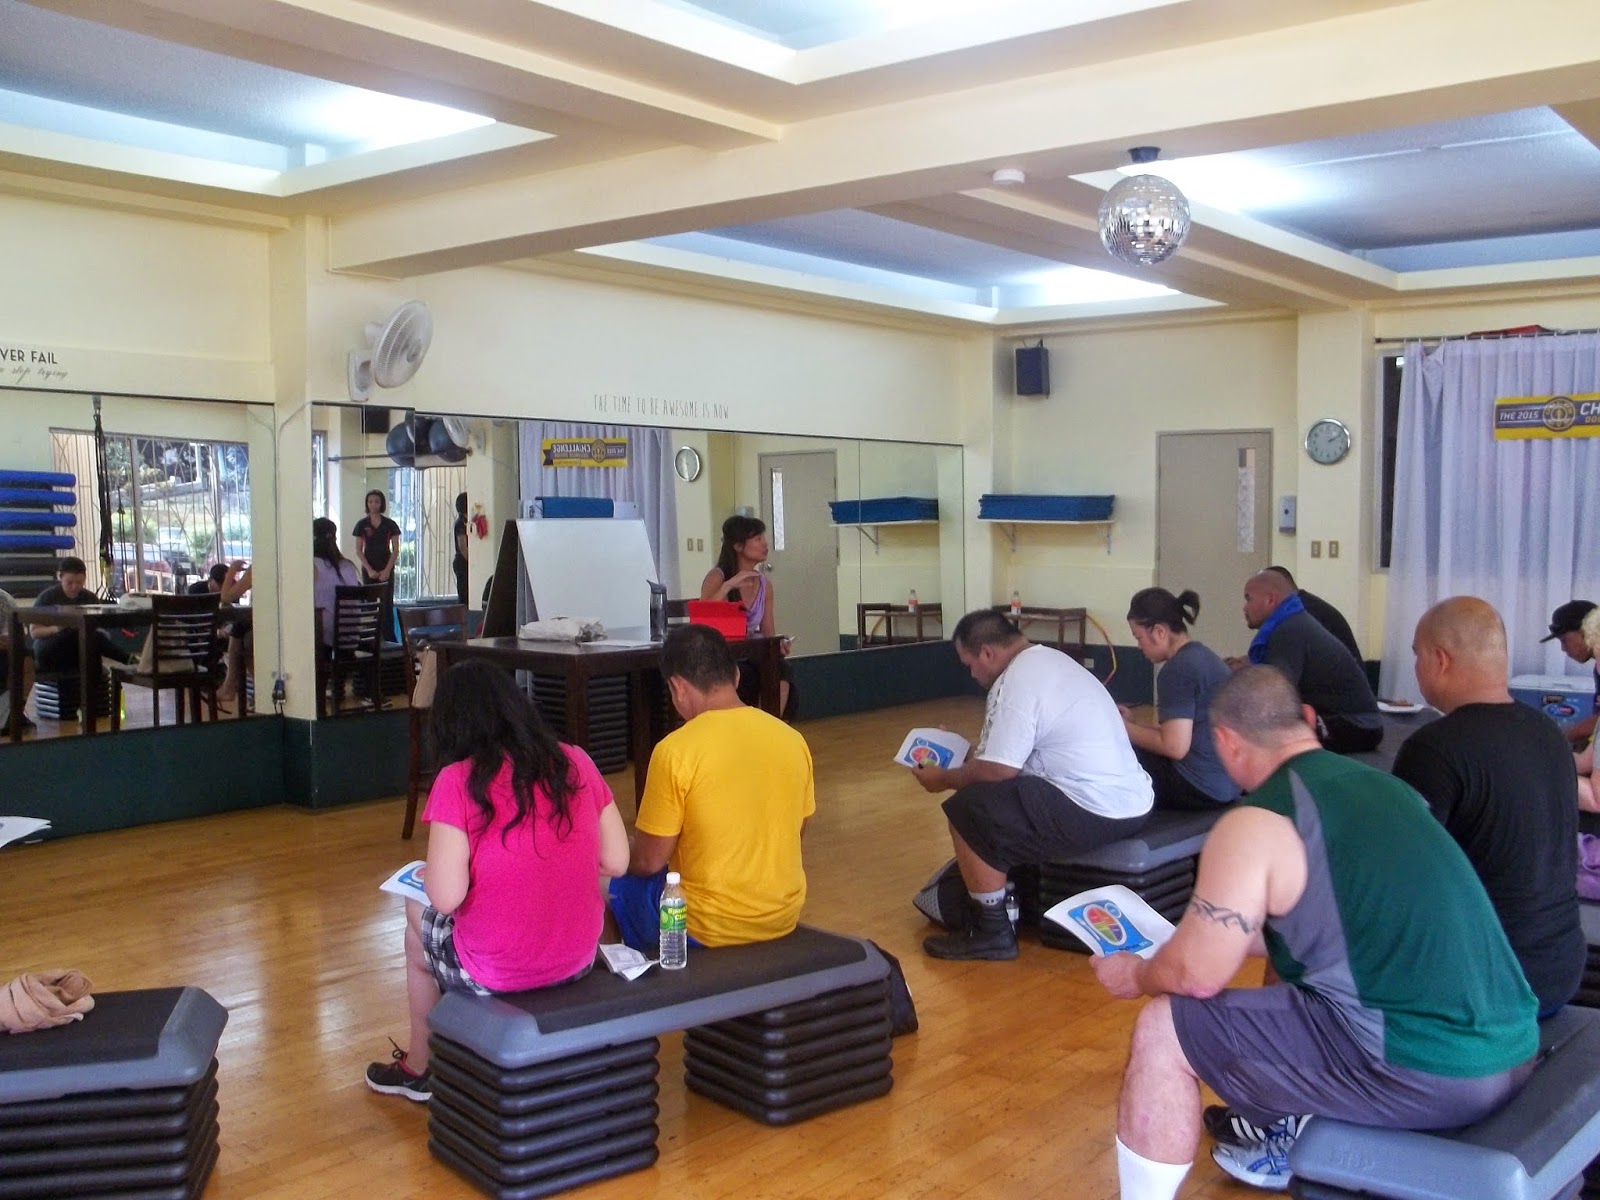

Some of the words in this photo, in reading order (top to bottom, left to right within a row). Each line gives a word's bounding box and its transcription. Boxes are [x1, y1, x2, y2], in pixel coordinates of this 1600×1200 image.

[31, 350, 58, 365] FAIL
[593, 394, 607, 412] THE
[613, 395, 631, 413] TIME
[637, 397, 646, 415] TO
[650, 397, 658, 415] BE
[663, 400, 697, 418] AWESOME
[702, 402, 710, 418] IS
[713, 403, 729, 419] NOW
[1500, 411, 1516, 421] THE
[1517, 410, 1540, 420] 2015
